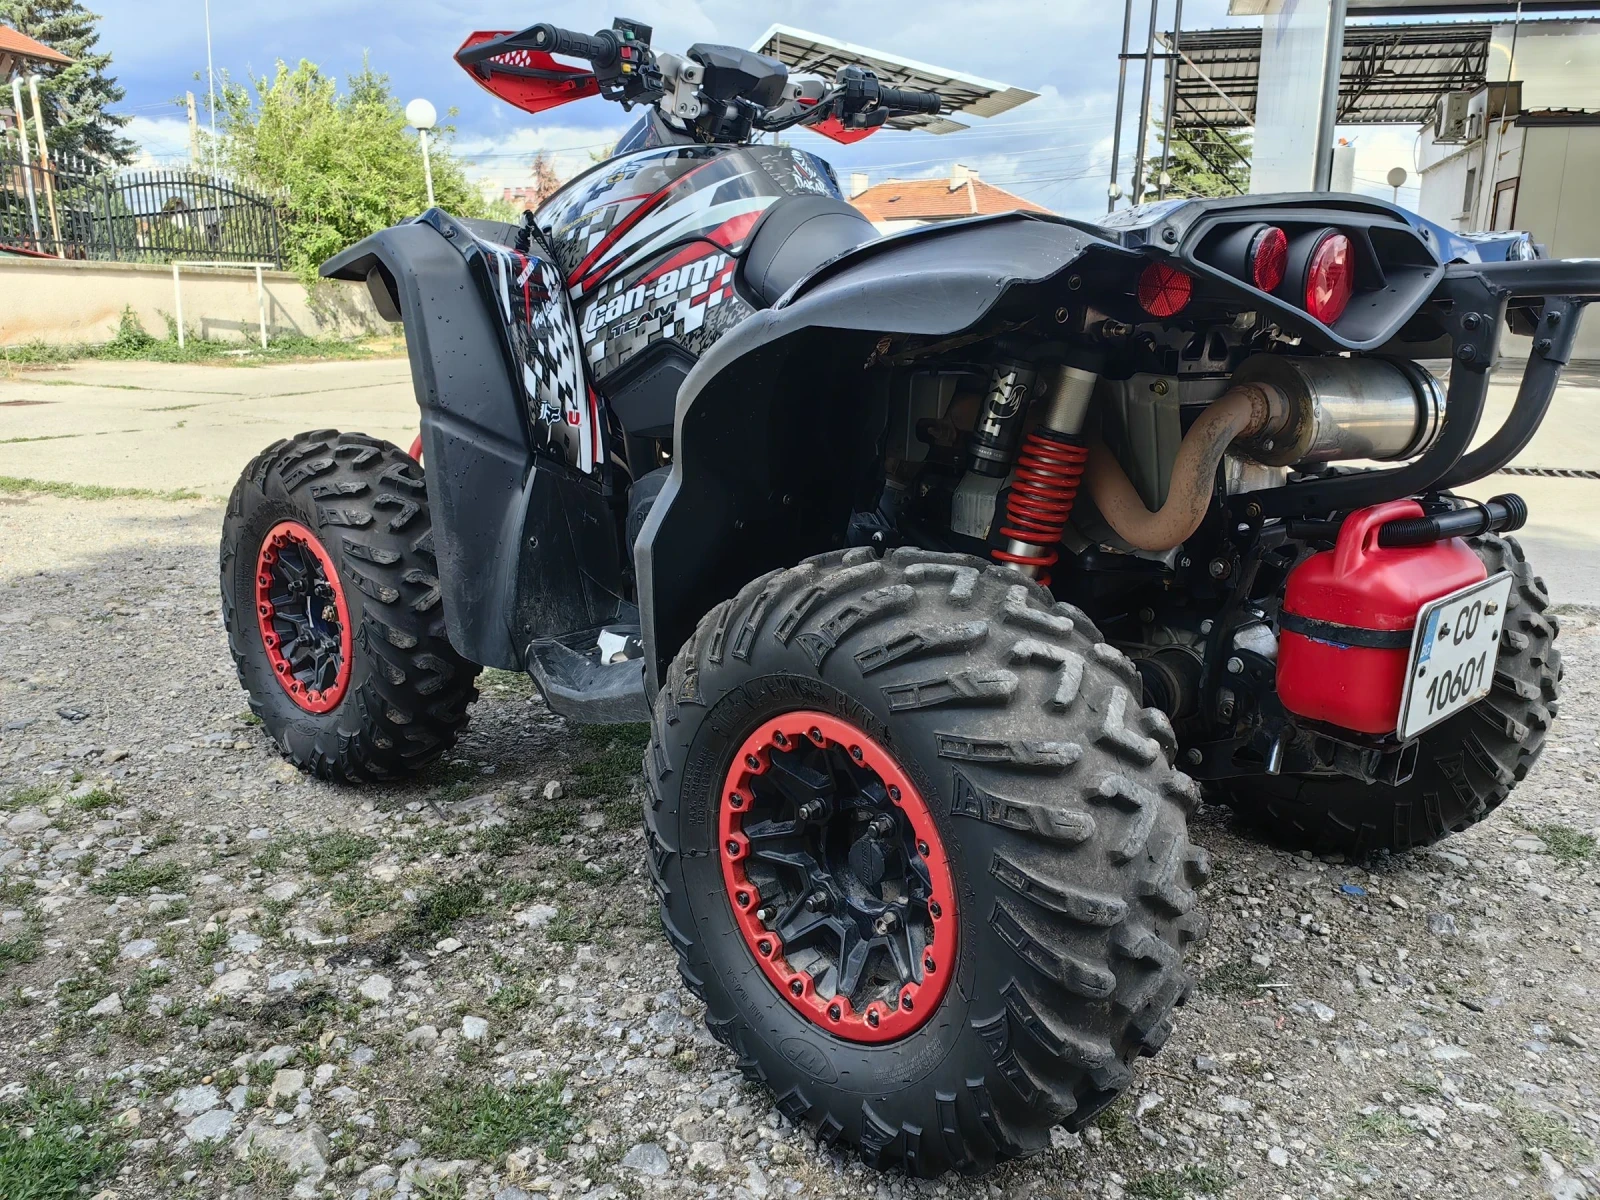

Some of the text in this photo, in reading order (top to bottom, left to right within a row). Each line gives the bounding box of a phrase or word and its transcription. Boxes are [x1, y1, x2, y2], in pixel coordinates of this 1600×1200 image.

[586, 254, 728, 333] can-am
[611, 302, 678, 339] TEAM
[978, 369, 1027, 437] FOX
[1453, 600, 1482, 646] CO
[1426, 651, 1487, 715] 10601
